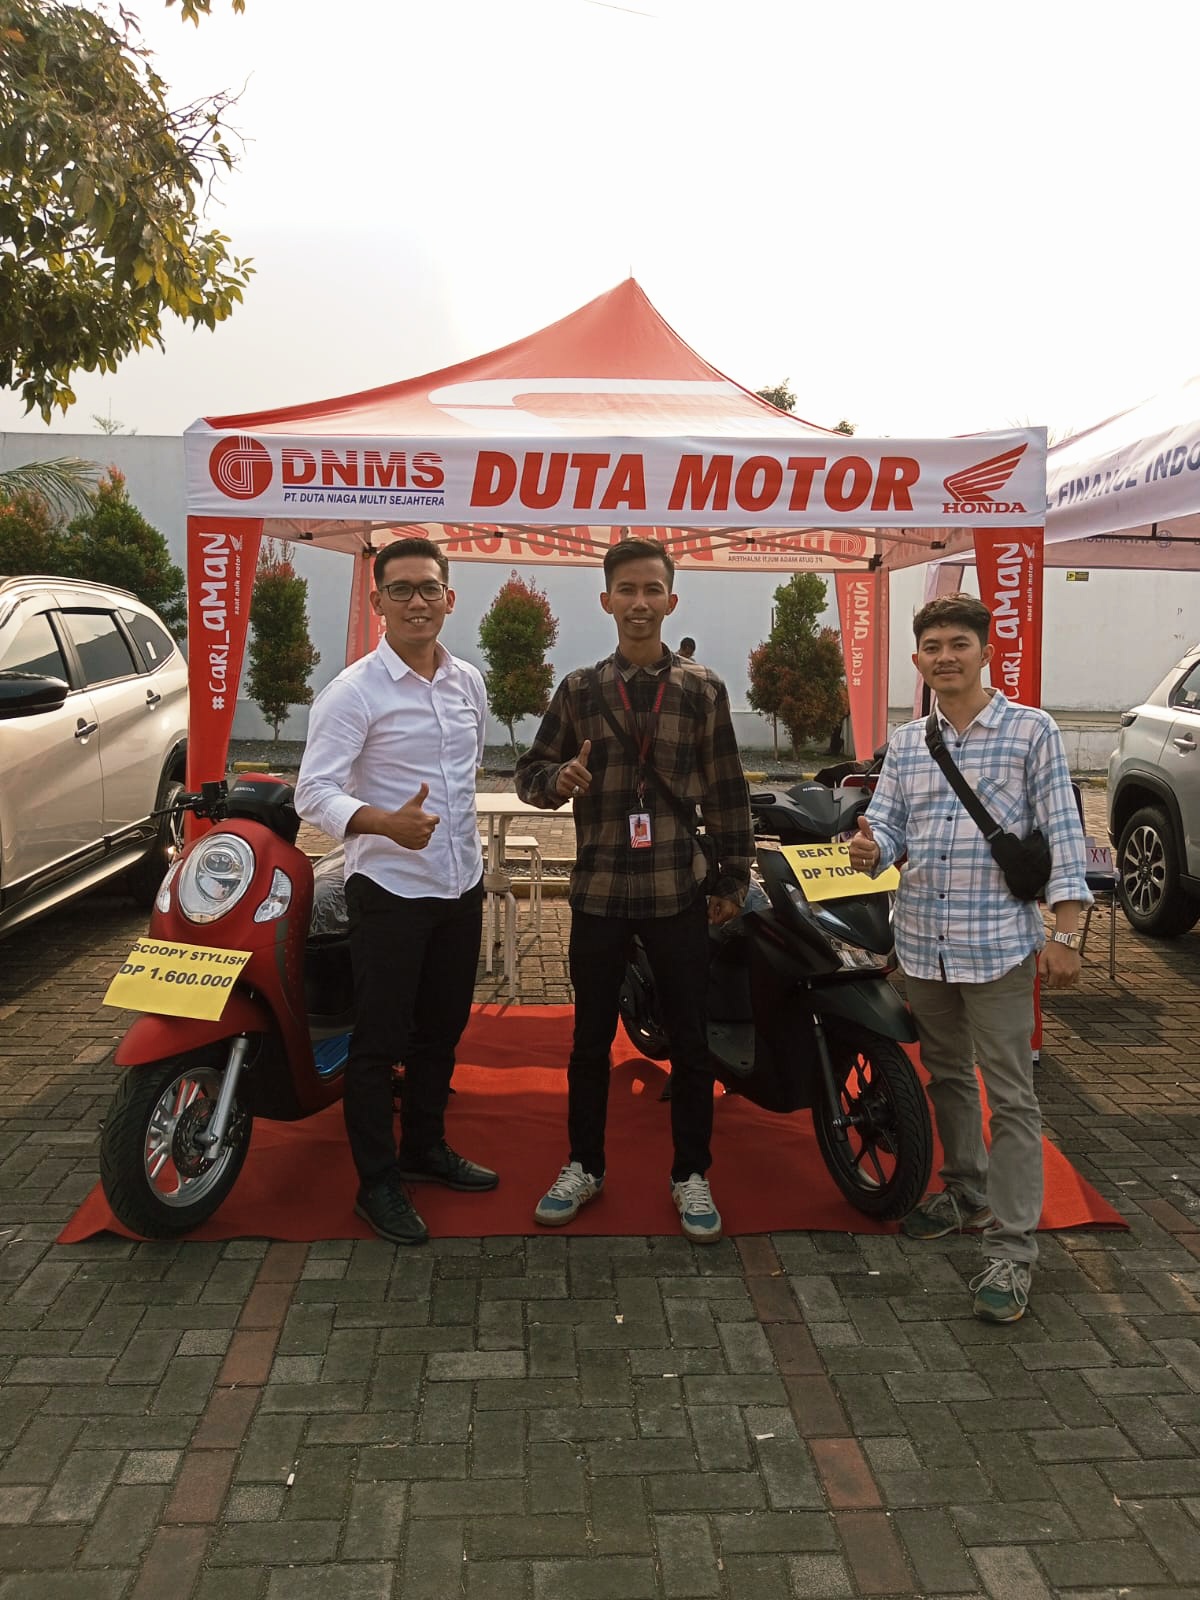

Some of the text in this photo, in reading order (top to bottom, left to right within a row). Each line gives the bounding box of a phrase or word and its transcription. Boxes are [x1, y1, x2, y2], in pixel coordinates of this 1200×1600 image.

[282, 448, 445, 488] DNMS
[470, 450, 921, 512] DUTA MOTOR
[284, 492, 445, 507] PT. DUTA NIAGA MULTI SEJAHTERA
[942, 501, 1027, 514] HONDA
[796, 847, 833, 858] BEAT
[801, 868, 821, 879] DP
[132, 943, 248, 966] SCOOPY STYLISH
[119, 963, 233, 988] DP 1.600.000
